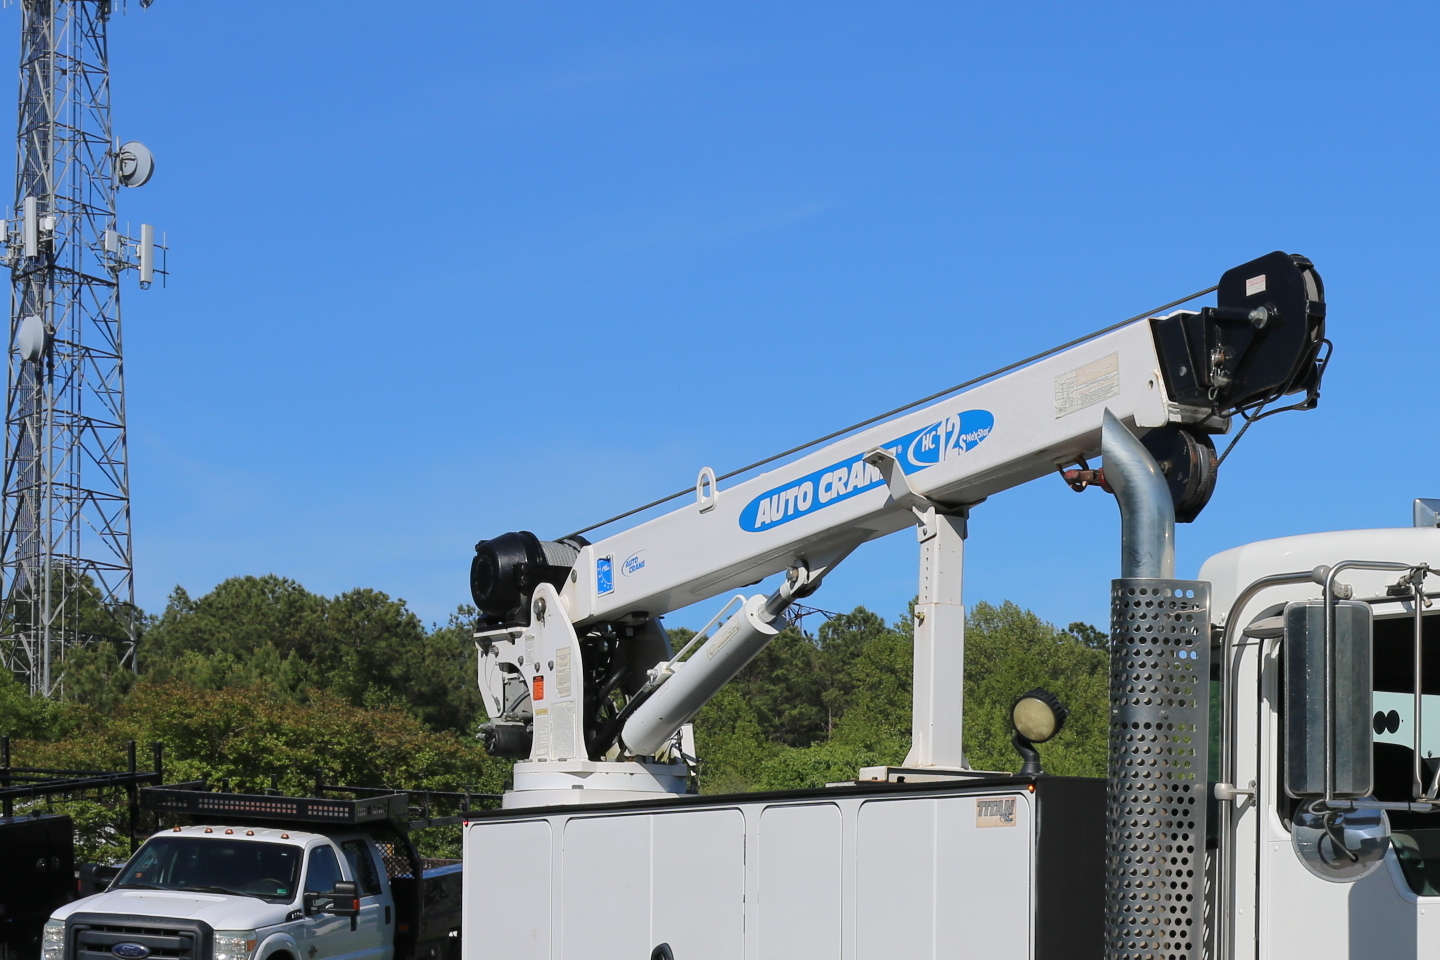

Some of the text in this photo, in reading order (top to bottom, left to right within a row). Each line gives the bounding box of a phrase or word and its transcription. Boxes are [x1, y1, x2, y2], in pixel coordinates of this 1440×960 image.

[754, 446, 896, 529] AUTO CRAN
[625, 556, 639, 568] AUTO
[629, 560, 646, 574] CRANE
[977, 800, 1015, 817] TITAN
[120, 945, 140, 956] Ford
